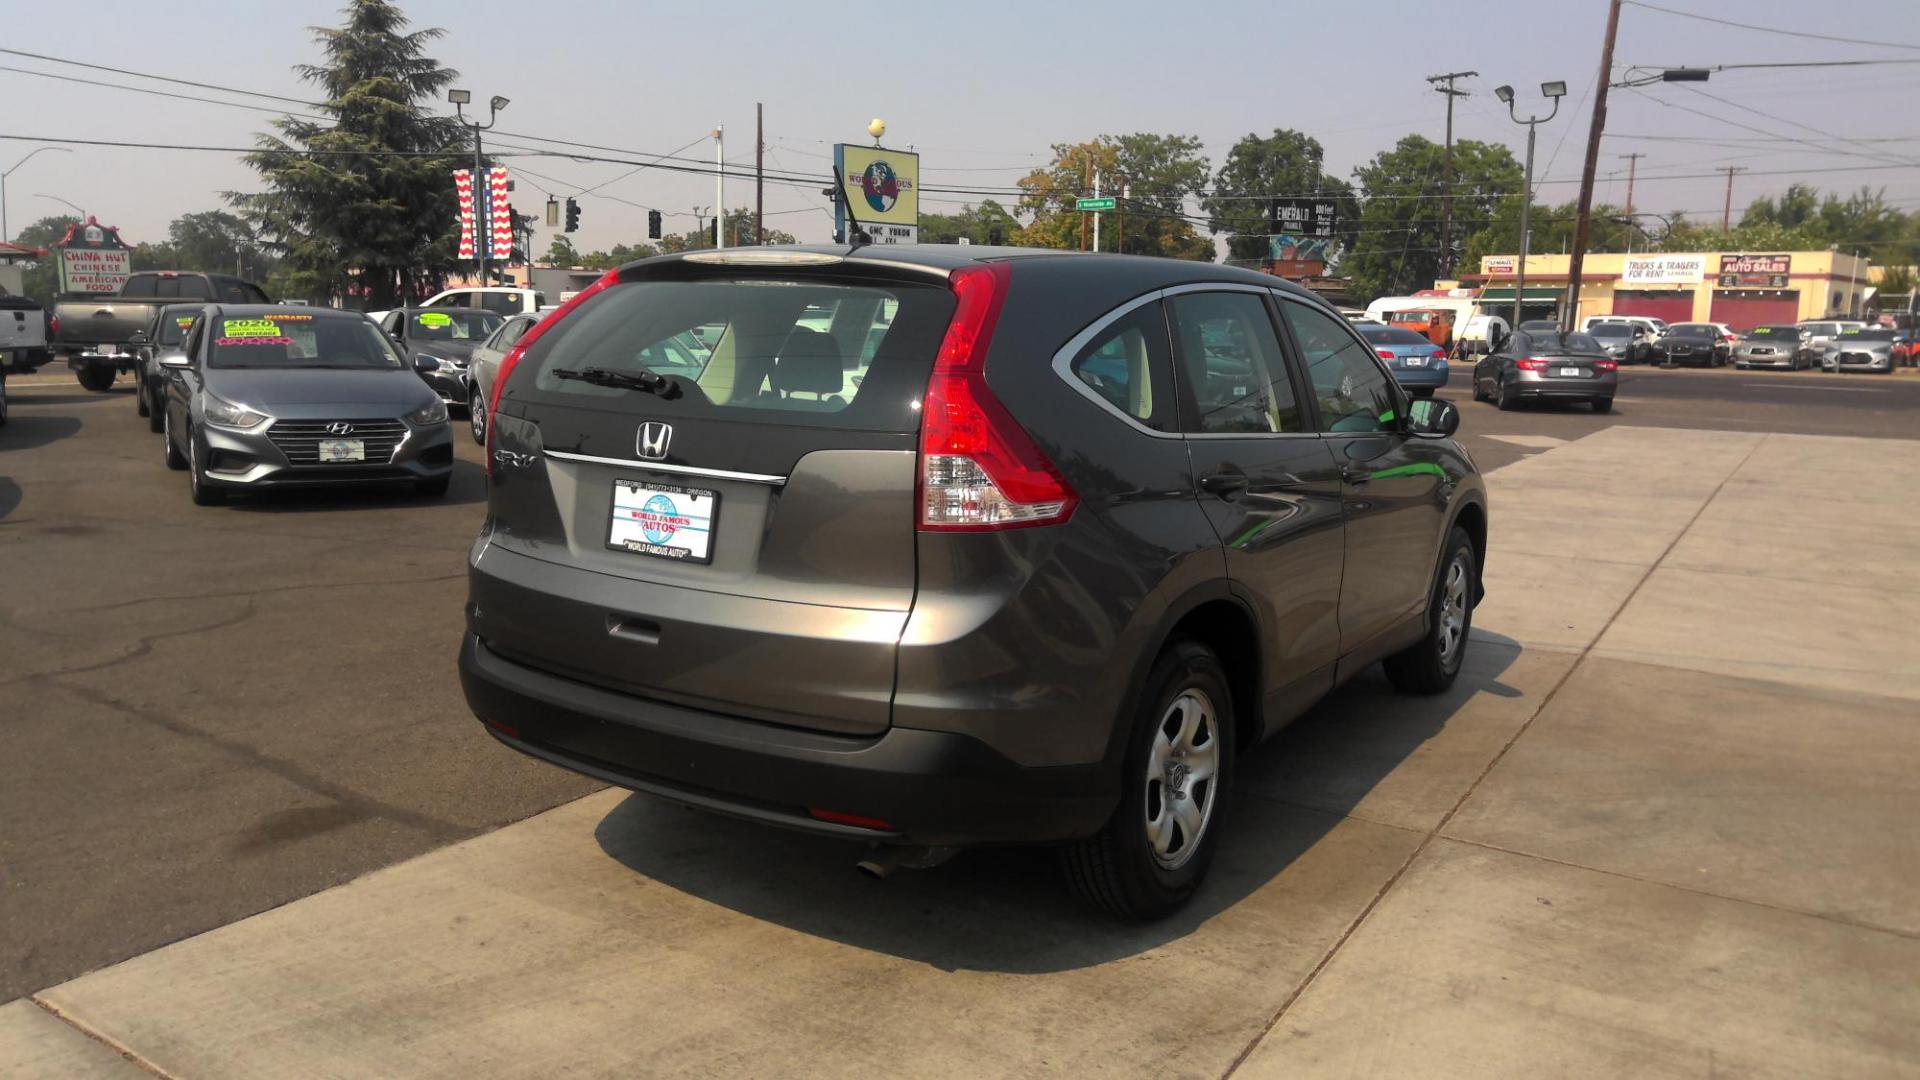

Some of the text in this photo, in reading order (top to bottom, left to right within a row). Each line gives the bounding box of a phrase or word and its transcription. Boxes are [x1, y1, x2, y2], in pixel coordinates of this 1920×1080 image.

[1277, 206, 1310, 221] EMERALD
[485, 195, 493, 254] FINANCE
[869, 226, 910, 237] GMC YUKON
[65, 251, 126, 262] CHINA HUT
[73, 264, 120, 272] CHINESE
[1628, 261, 1655, 270] TRUCKS
[1724, 263, 1786, 272] AUTO SALES
[71, 276, 125, 284] AMERICAN
[615, 480, 643, 488] MEDFORD
[686, 488, 713, 496] OREGON
[631, 512, 691, 526] WORLD FAMOUS
[642, 522, 676, 534] AUTOS
[646, 544, 669, 556] FAMOUS
